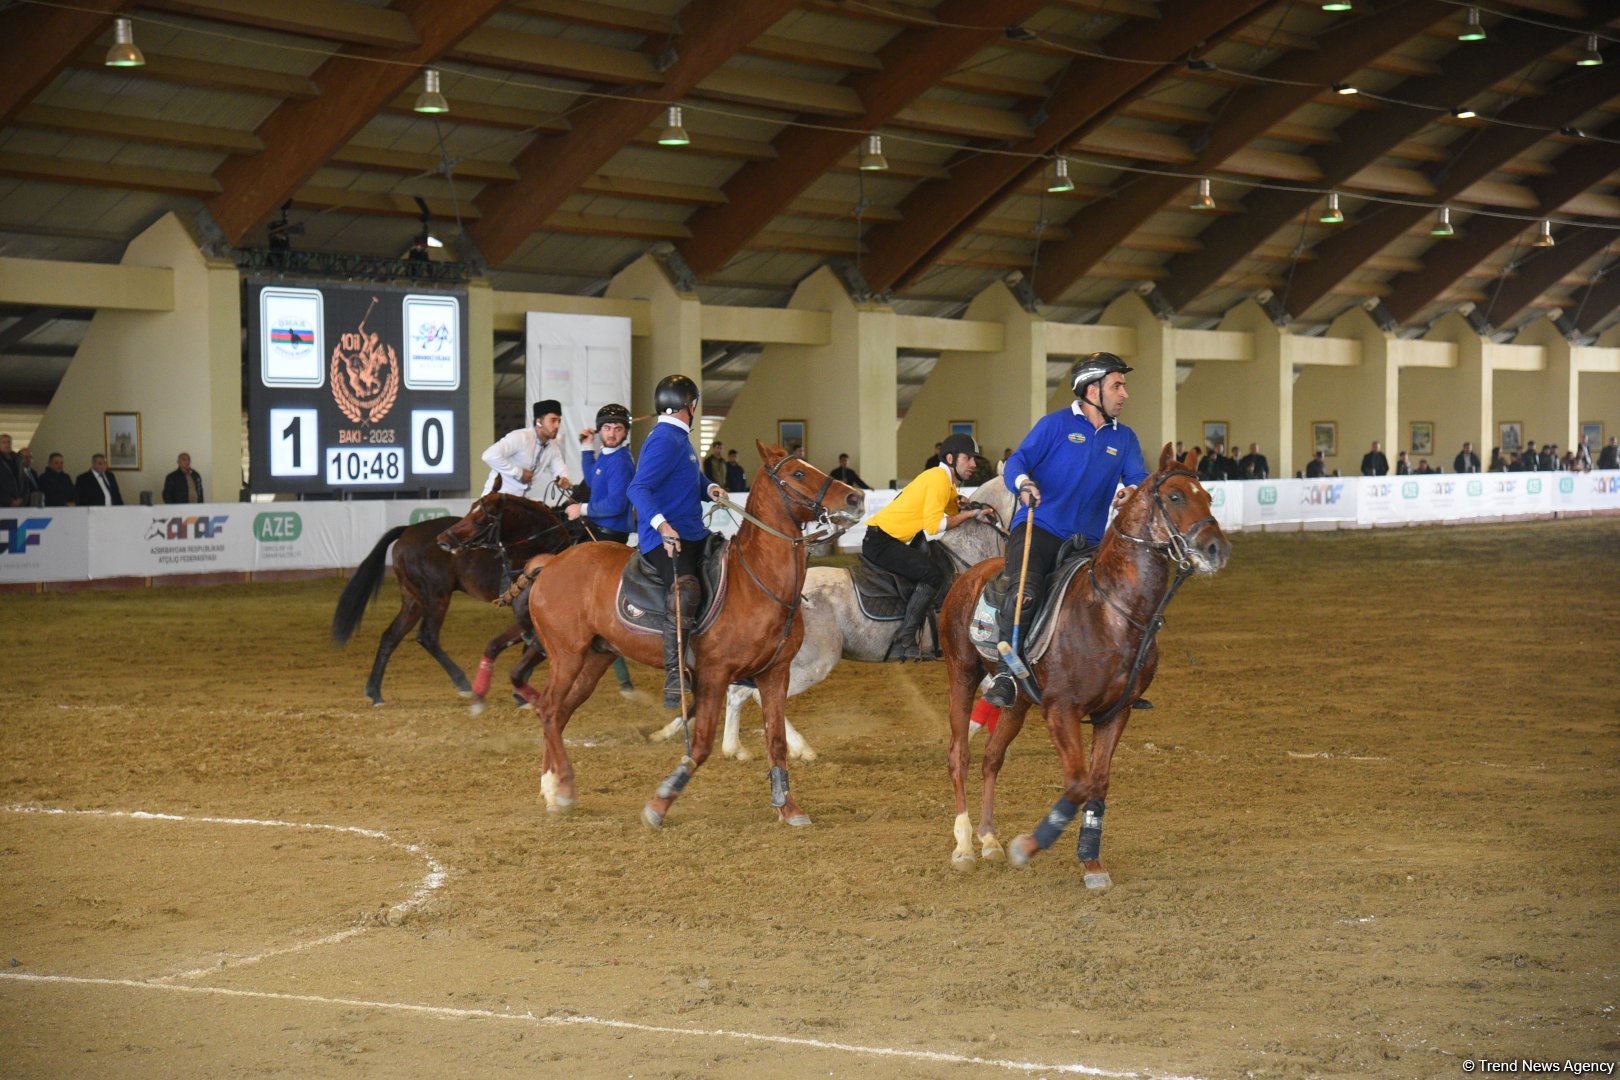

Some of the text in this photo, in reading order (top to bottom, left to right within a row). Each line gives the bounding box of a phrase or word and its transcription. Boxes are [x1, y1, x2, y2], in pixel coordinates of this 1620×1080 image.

[282, 416, 301, 467] 1
[369, 429, 395, 443] 2023
[422, 417, 444, 467] 0
[332, 452, 399, 480] 10:48
[261, 517, 294, 537] AZE
